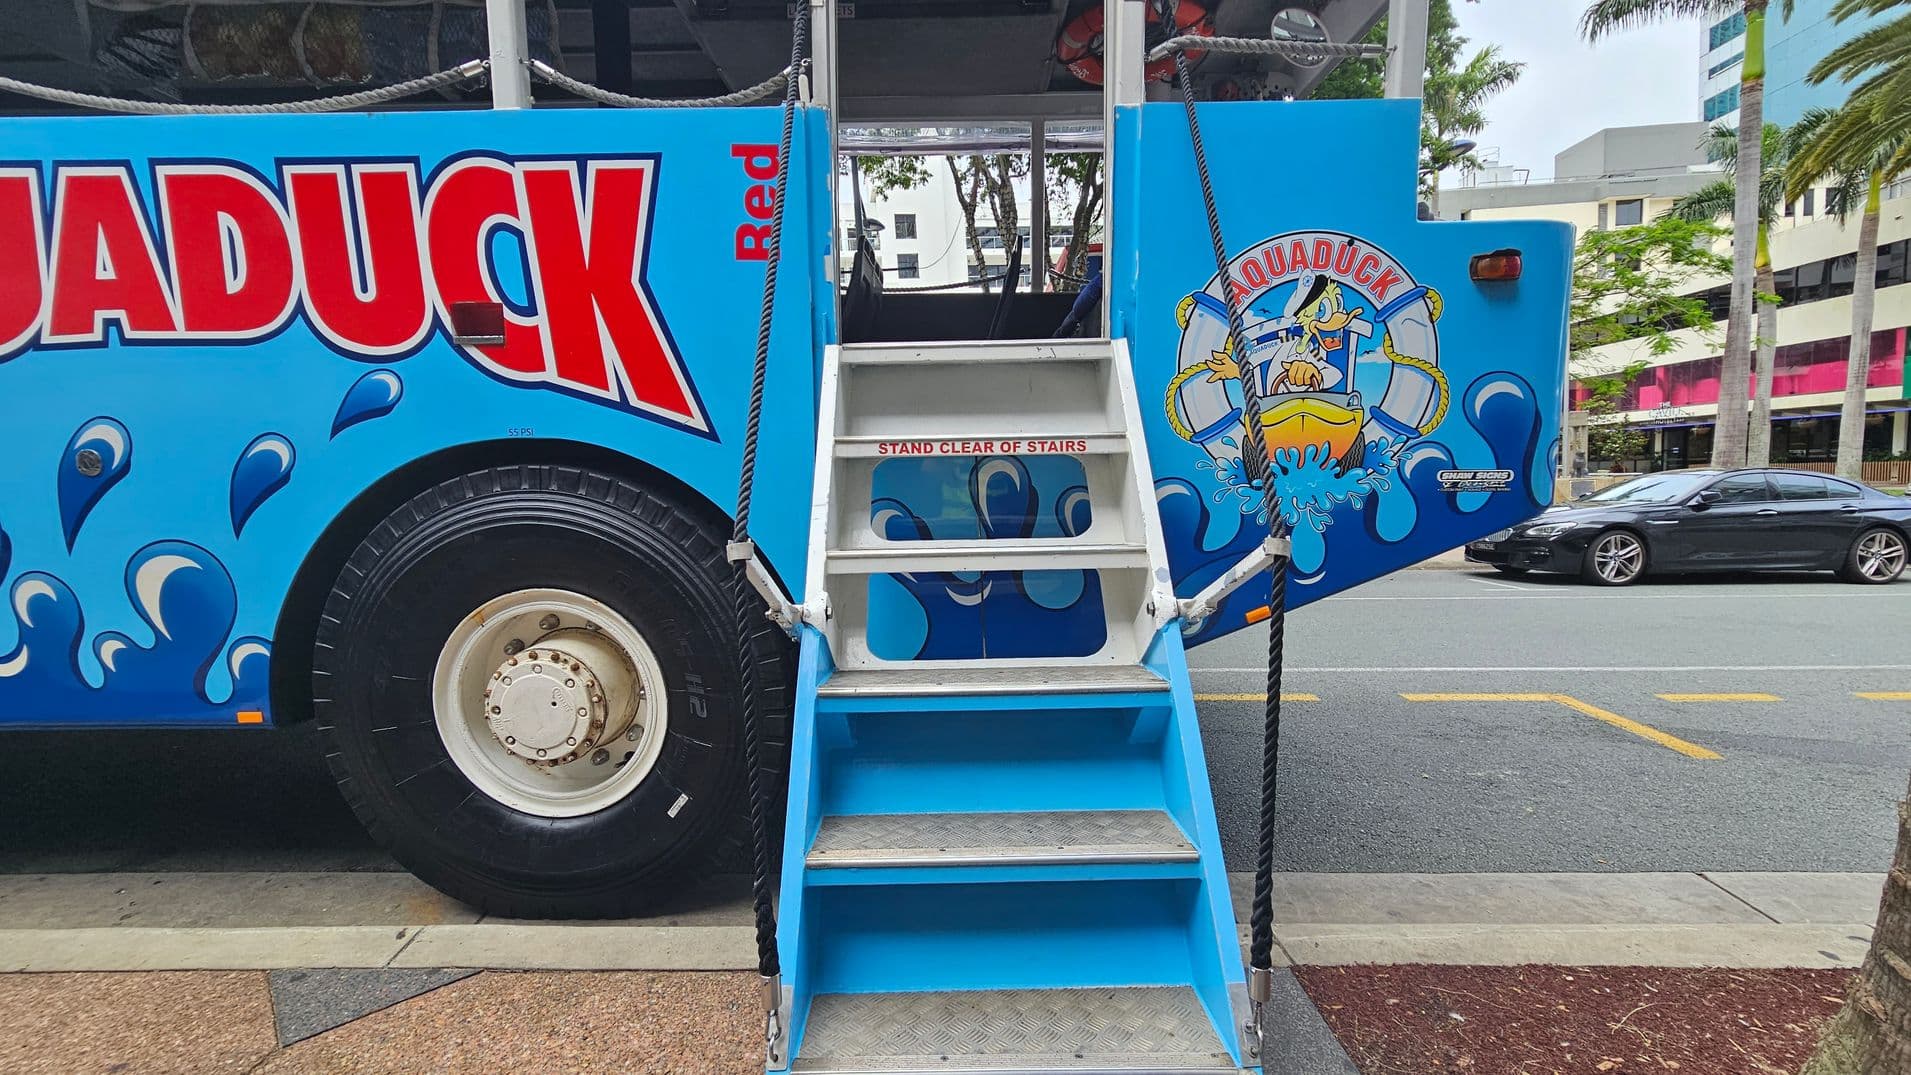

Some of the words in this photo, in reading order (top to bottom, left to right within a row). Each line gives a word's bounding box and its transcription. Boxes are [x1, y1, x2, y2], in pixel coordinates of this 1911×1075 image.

[732, 143, 780, 261] Red
[520, 428, 534, 437] PSI
[878, 442, 934, 455] STAND
[939, 441, 994, 454] CLEAR
[999, 441, 1021, 453] OF
[1027, 440, 1087, 453] STAIRS
[1441, 472, 1474, 480] SHAW
[1475, 472, 1509, 480] SIGNS
